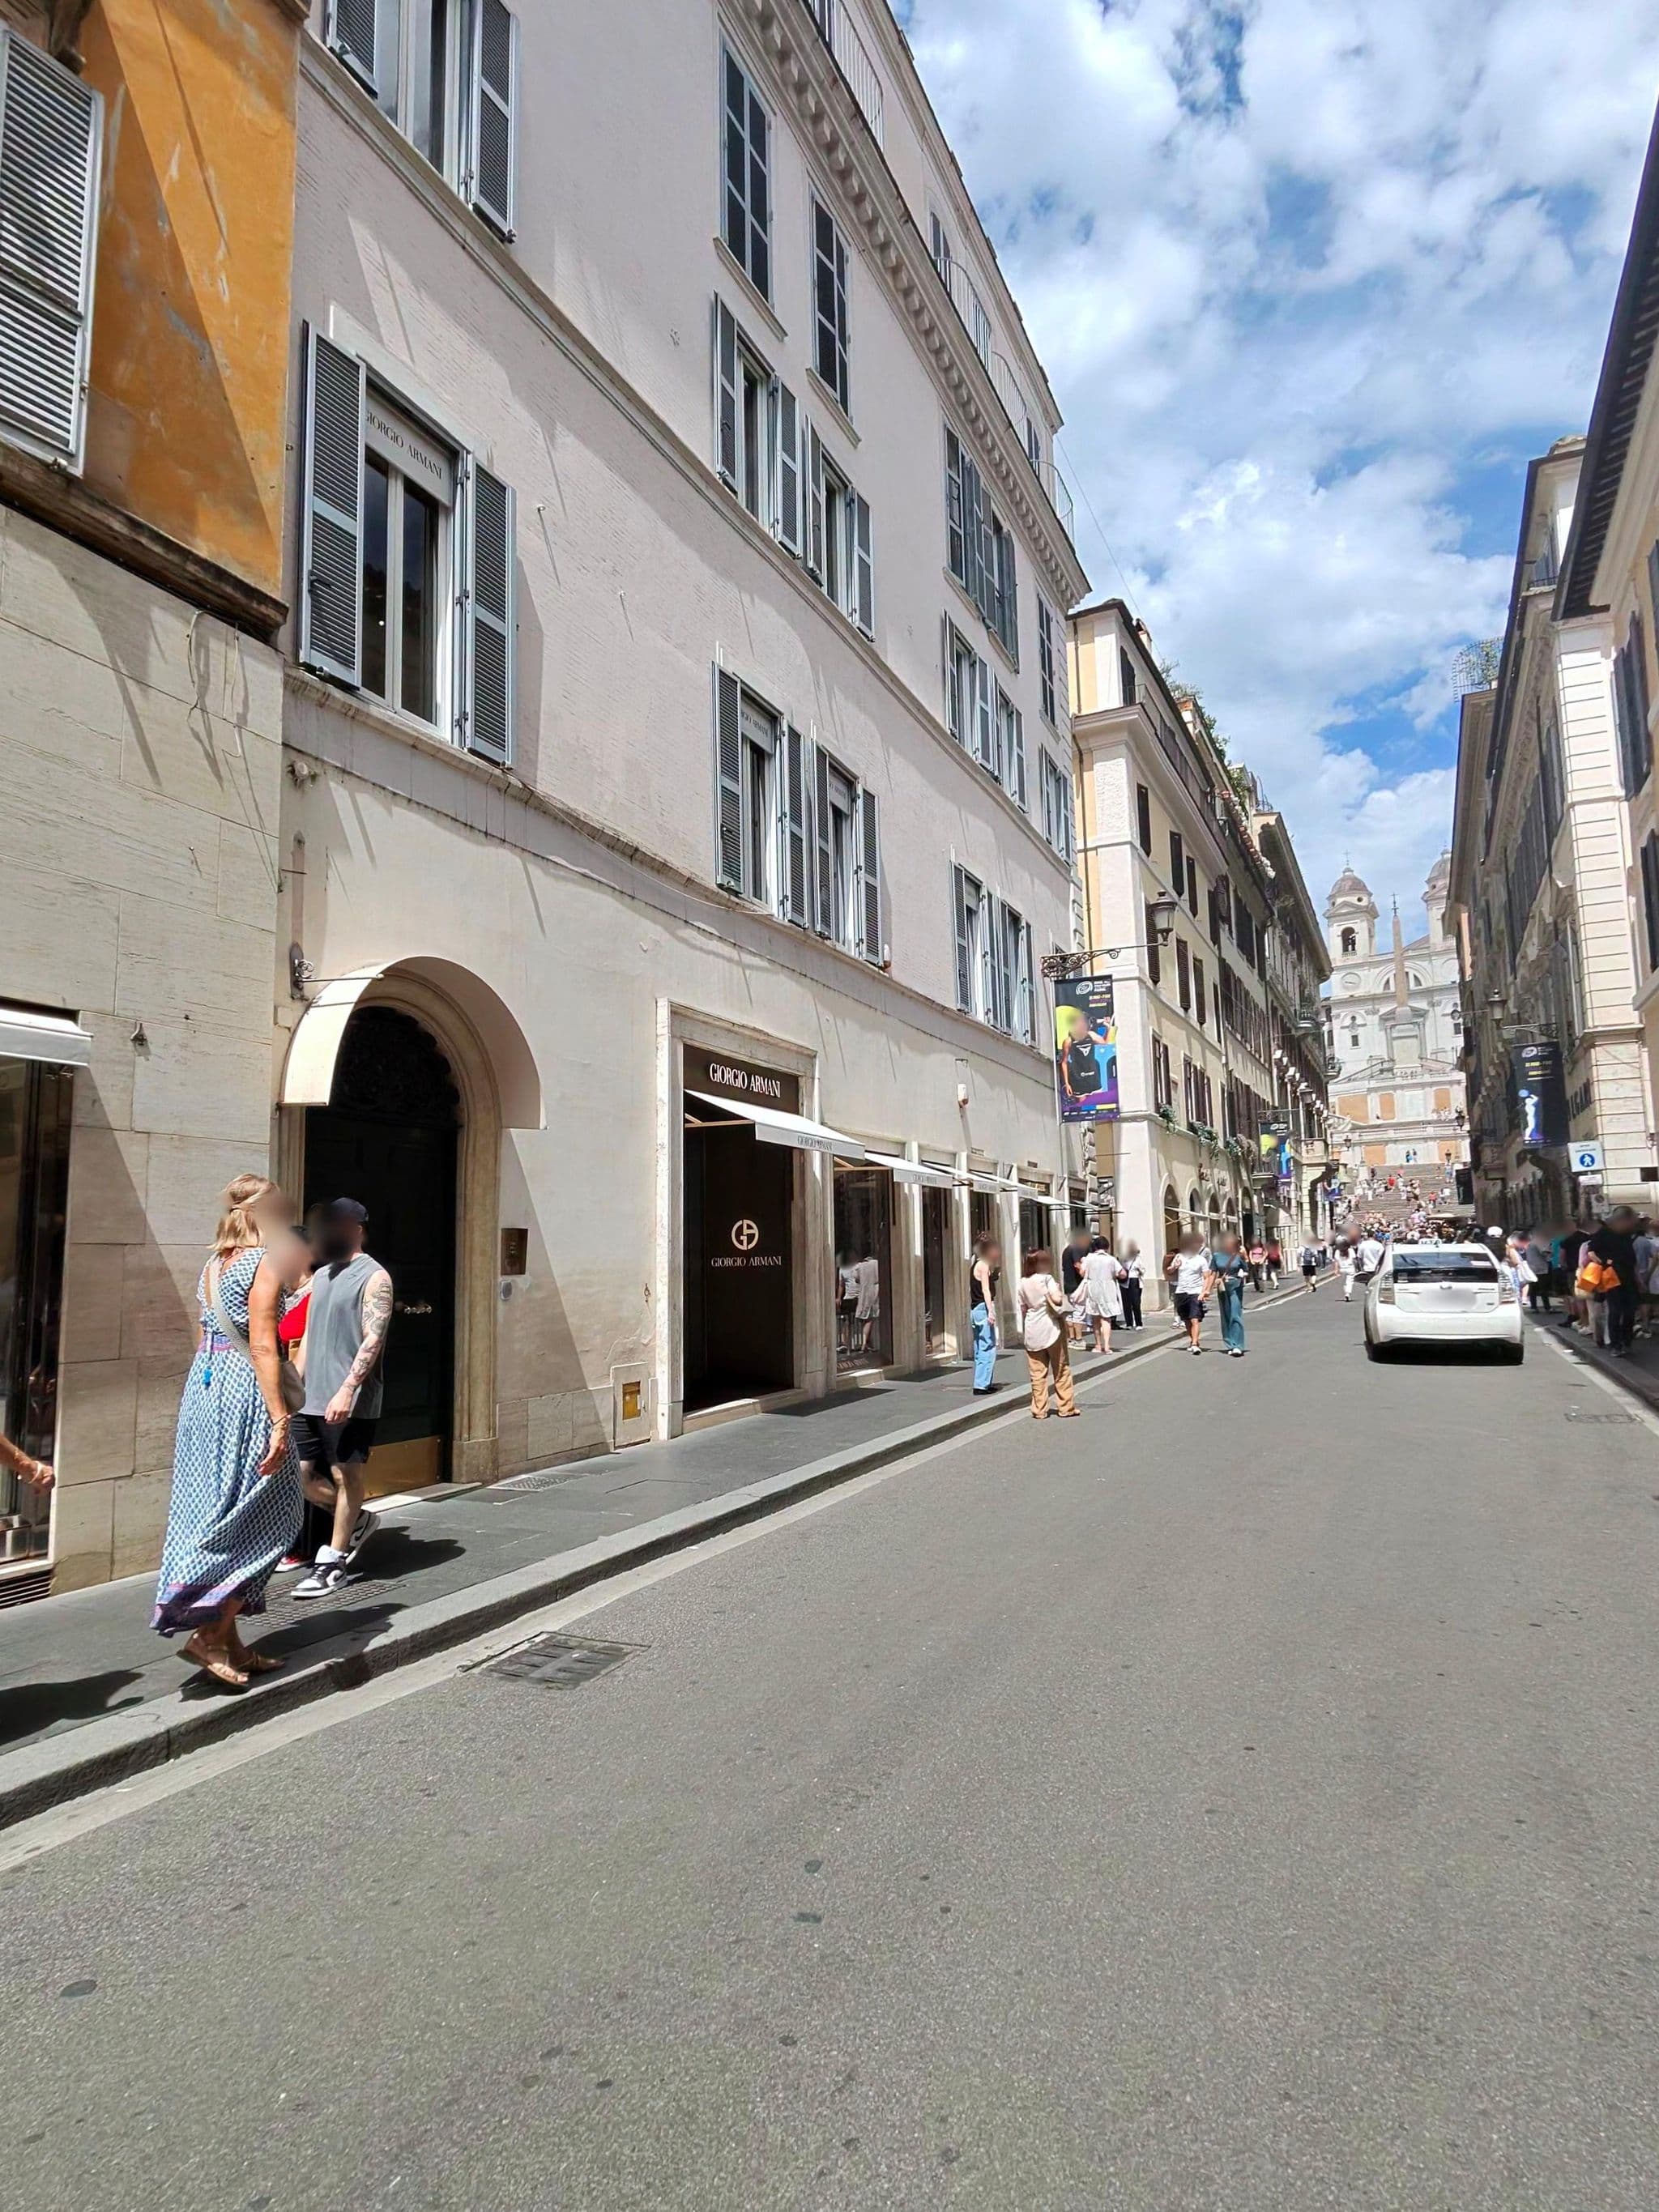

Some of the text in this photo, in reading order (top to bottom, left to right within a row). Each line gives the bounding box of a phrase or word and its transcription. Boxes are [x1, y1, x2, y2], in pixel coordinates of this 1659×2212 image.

[407, 445, 441, 479] ARMANI
[710, 1063, 780, 1097] GIORGIO ARMANI
[711, 1255, 782, 1268] GIORGIO ARMANI
